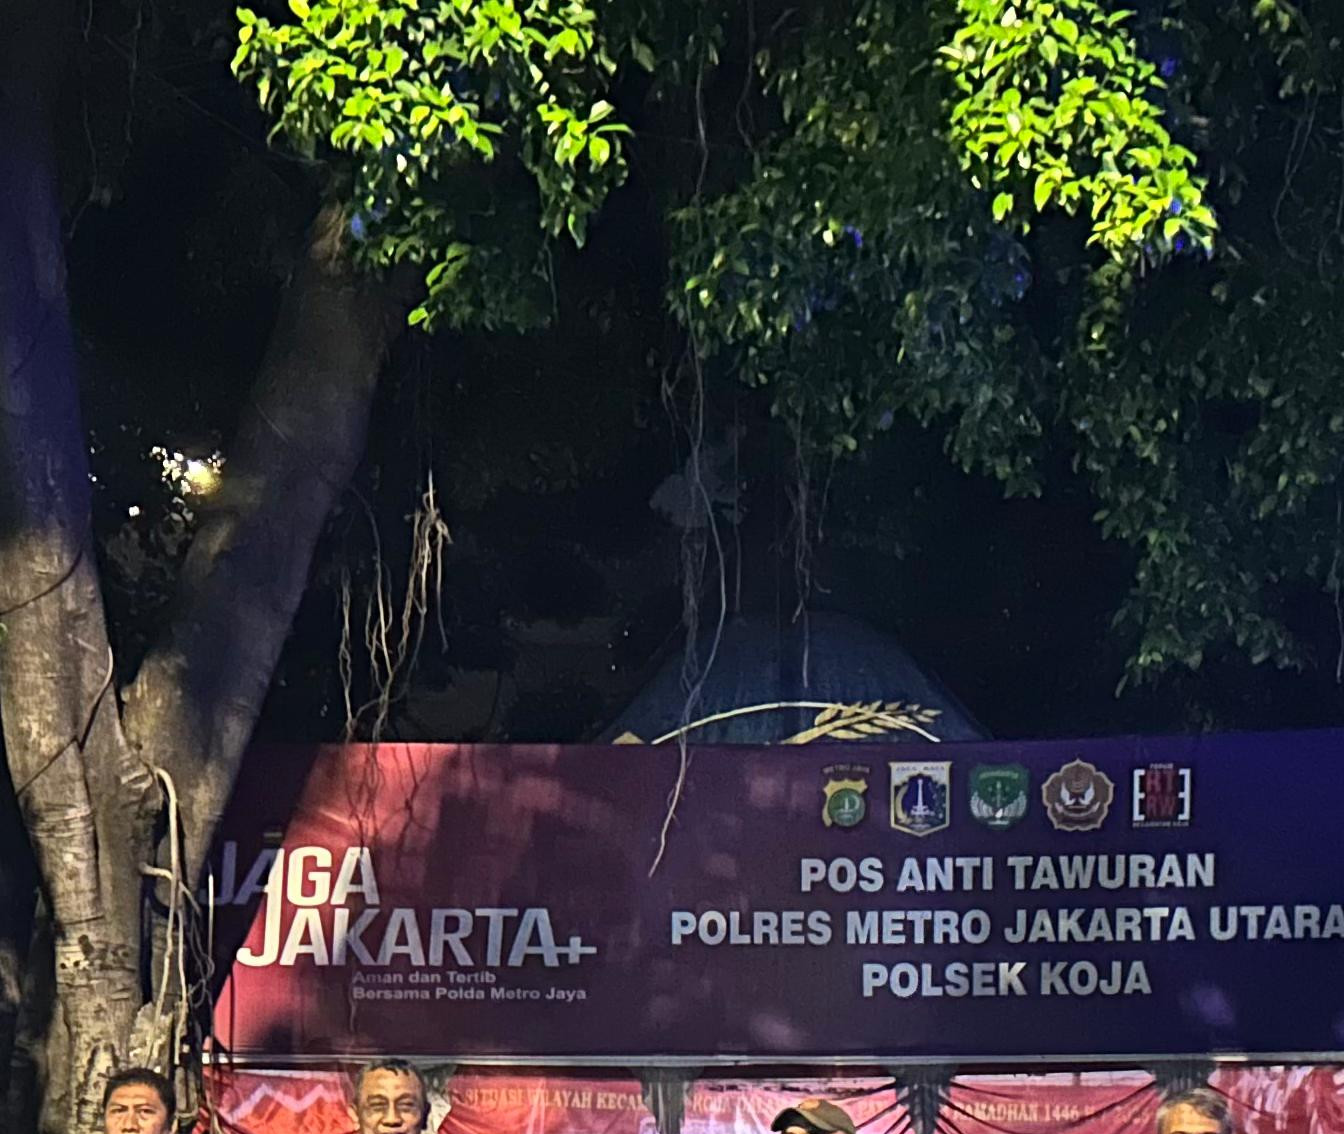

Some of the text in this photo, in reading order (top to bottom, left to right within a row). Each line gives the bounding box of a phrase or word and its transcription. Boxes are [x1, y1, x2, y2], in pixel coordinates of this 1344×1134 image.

[199, 841, 381, 907] JAGA
[800, 853, 1216, 891] POS ANTI TAWURAN
[671, 911, 831, 945] POLRES
[846, 909, 991, 944] METRO
[1004, 906, 1195, 943] JAKARTA
[352, 970, 497, 984] Aman dan Tertib
[353, 987, 587, 1002] Bersama Polda Metro Jaya
[862, 961, 1152, 998] POLSEK KOJA
[1044, 1104, 1081, 1122] 1446
